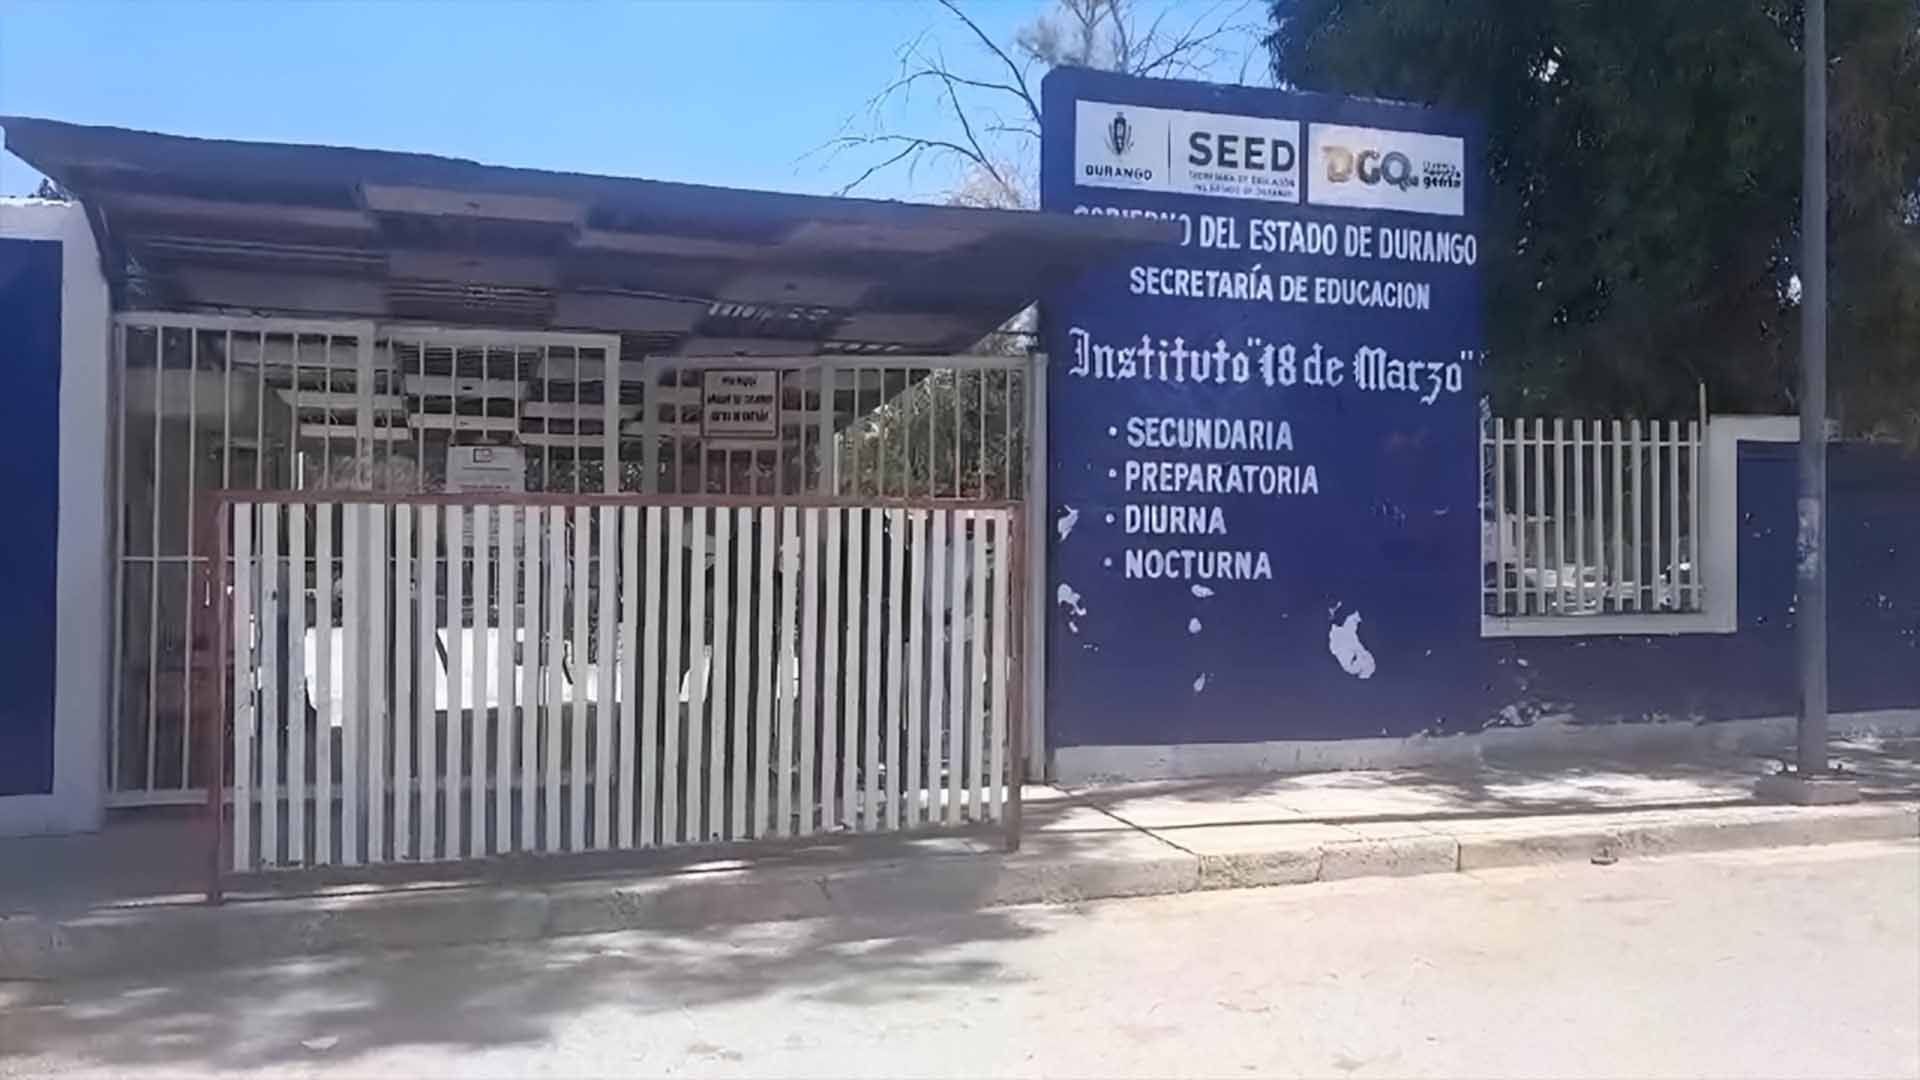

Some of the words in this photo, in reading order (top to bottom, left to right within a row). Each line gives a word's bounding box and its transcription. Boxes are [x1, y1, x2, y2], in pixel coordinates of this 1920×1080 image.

[1188, 131, 1296, 172] SEED
[1200, 214, 1241, 249] DEL
[1249, 219, 1338, 256] ESTADO
[1344, 226, 1372, 258] DE
[1379, 228, 1477, 266] DURANGO
[1129, 264, 1273, 302] SECRETARÍA
[1279, 275, 1308, 302] DE
[1314, 277, 1431, 310] EDUCACION
[1068, 327, 1250, 383] Instituto
[1303, 342, 1345, 386] de
[1126, 416, 1294, 451] SECUNDARIA
[1125, 460, 1319, 495] PREPARATORIA
[1125, 505, 1227, 535] DIURNA
[1125, 550, 1273, 580] NOCTURNA
